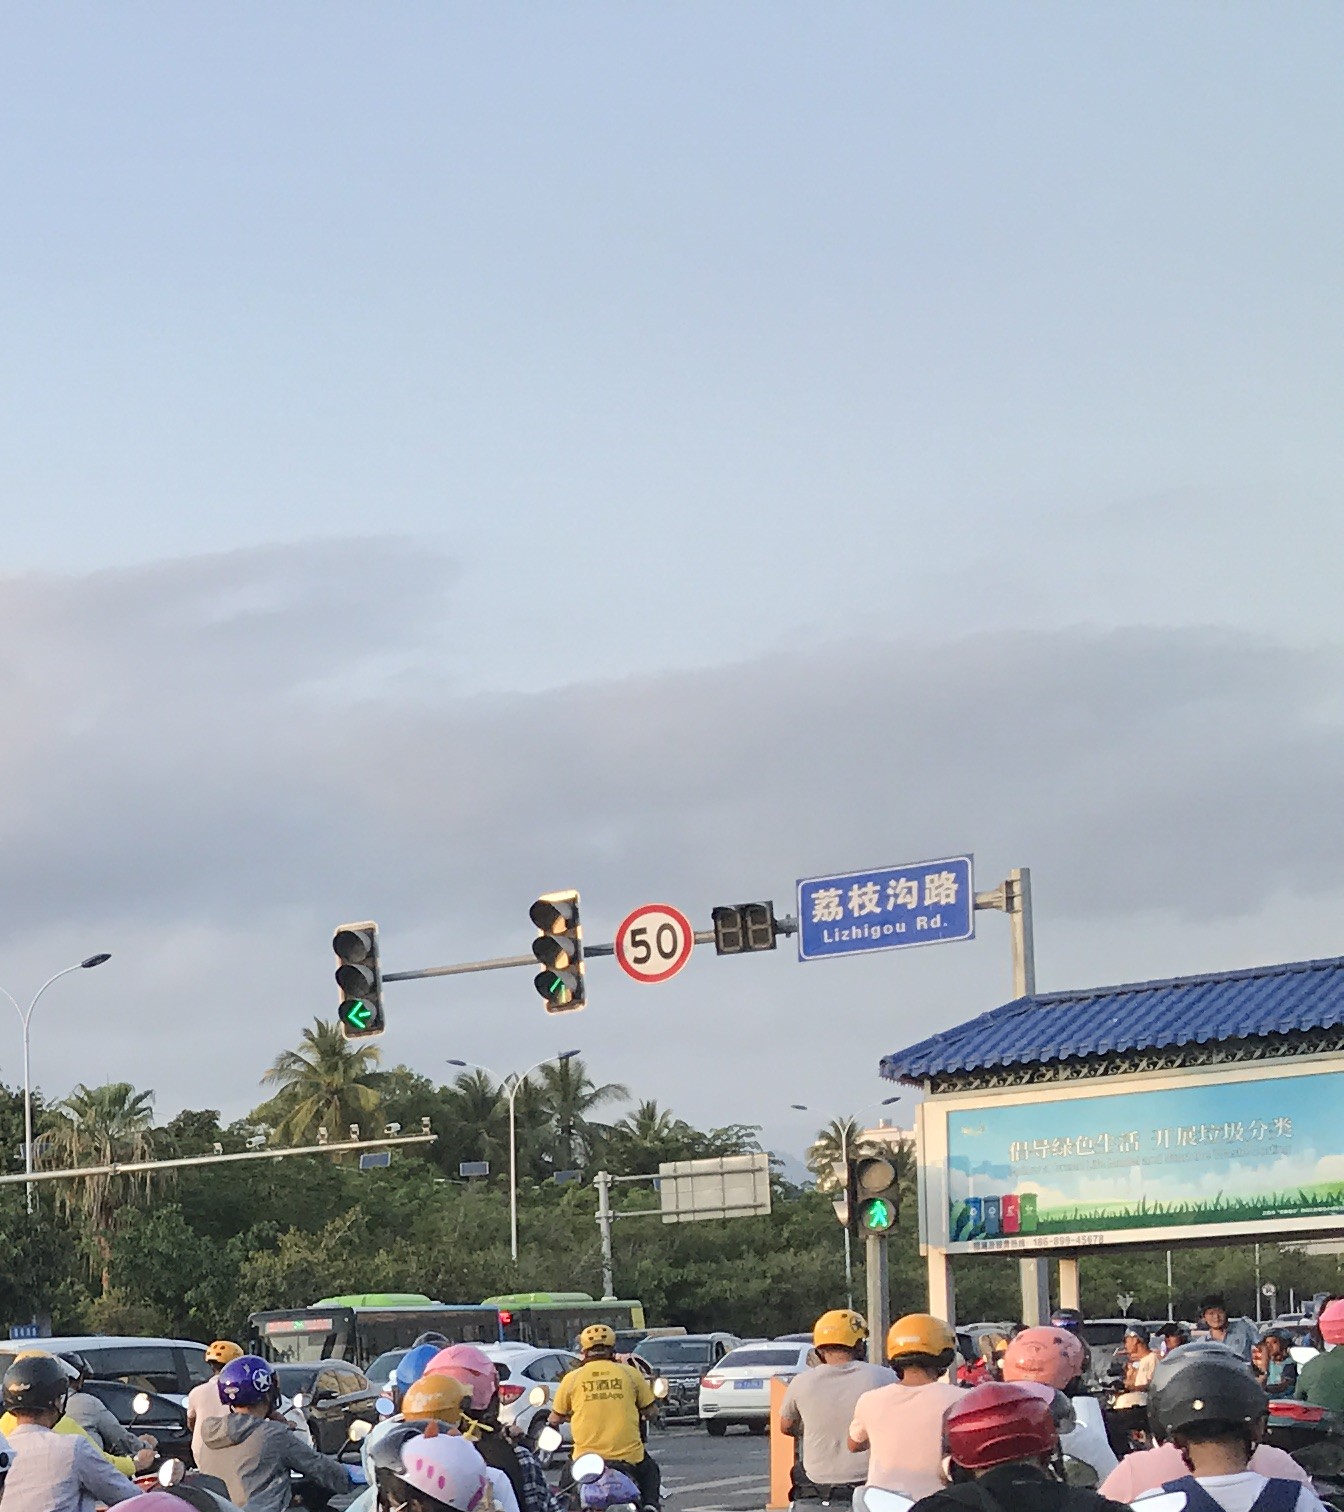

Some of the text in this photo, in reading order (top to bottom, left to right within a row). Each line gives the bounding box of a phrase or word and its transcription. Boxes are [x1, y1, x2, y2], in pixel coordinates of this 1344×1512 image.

[811, 870, 960, 923] 荔枝沟路
[629, 923, 679, 965] 50
[823, 914, 949, 943] Lizhigou Rd.
[1009, 1130, 1139, 1162] 倡导绿色生活
[1153, 1116, 1293, 1149] 开展垃圾分类
[582, 1378, 623, 1392] 订酒店
